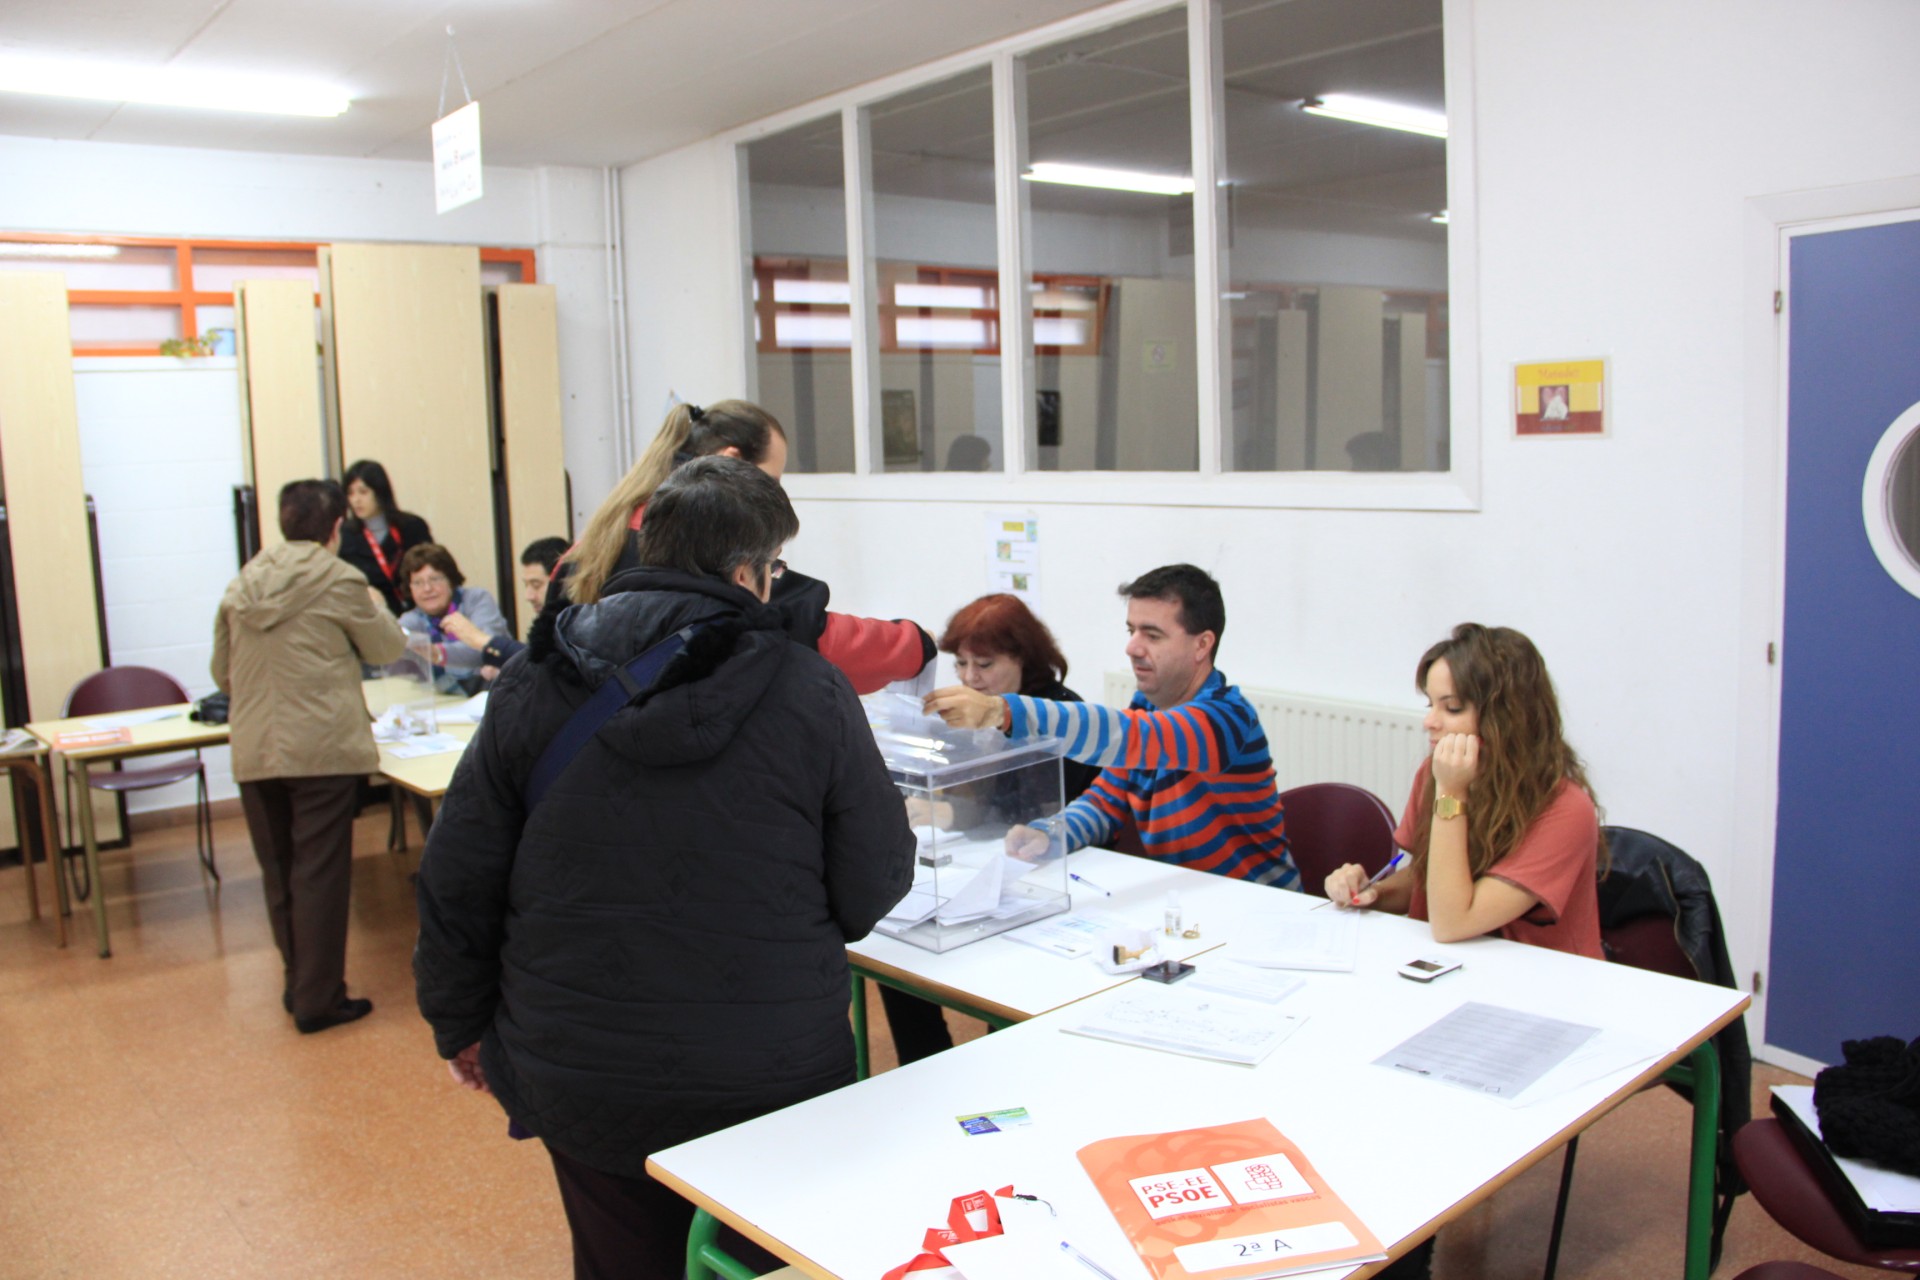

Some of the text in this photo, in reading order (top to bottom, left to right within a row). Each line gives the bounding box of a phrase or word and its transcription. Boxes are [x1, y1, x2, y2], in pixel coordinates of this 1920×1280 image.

[1141, 1175, 1209, 1195] PSE-EE
[1148, 1186, 1218, 1209] PSOE
[1274, 1239, 1293, 1252] A
